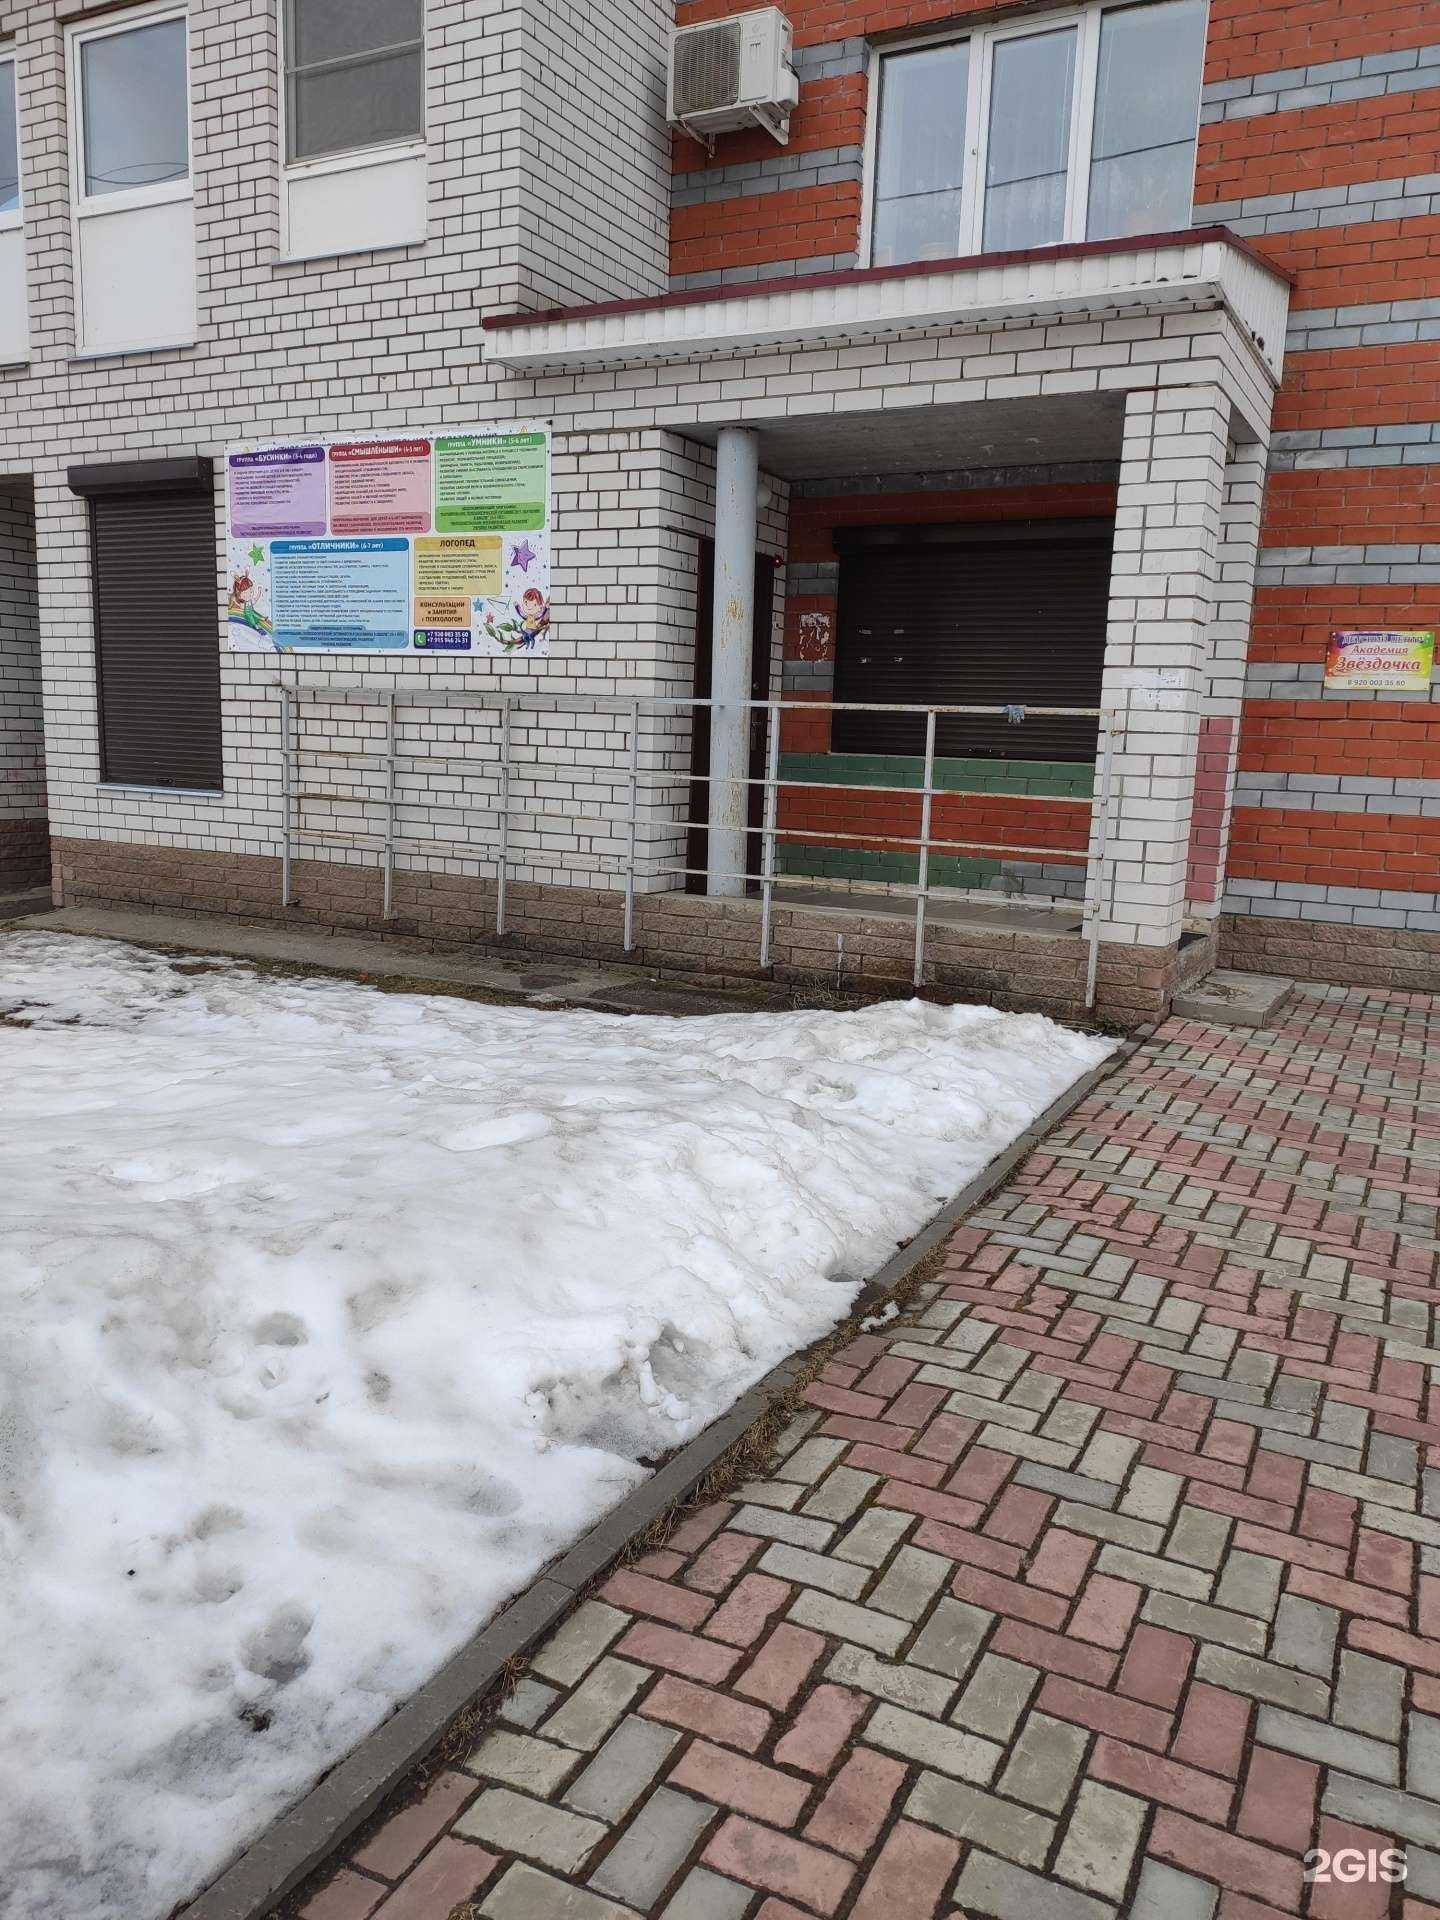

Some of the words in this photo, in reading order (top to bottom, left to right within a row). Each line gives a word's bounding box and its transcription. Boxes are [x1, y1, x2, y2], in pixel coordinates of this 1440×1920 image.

[440, 539, 476, 548] ЛОГОПЕД
[1351, 645, 1409, 655] Академия
[1336, 656, 1421, 672] Звёздочка
